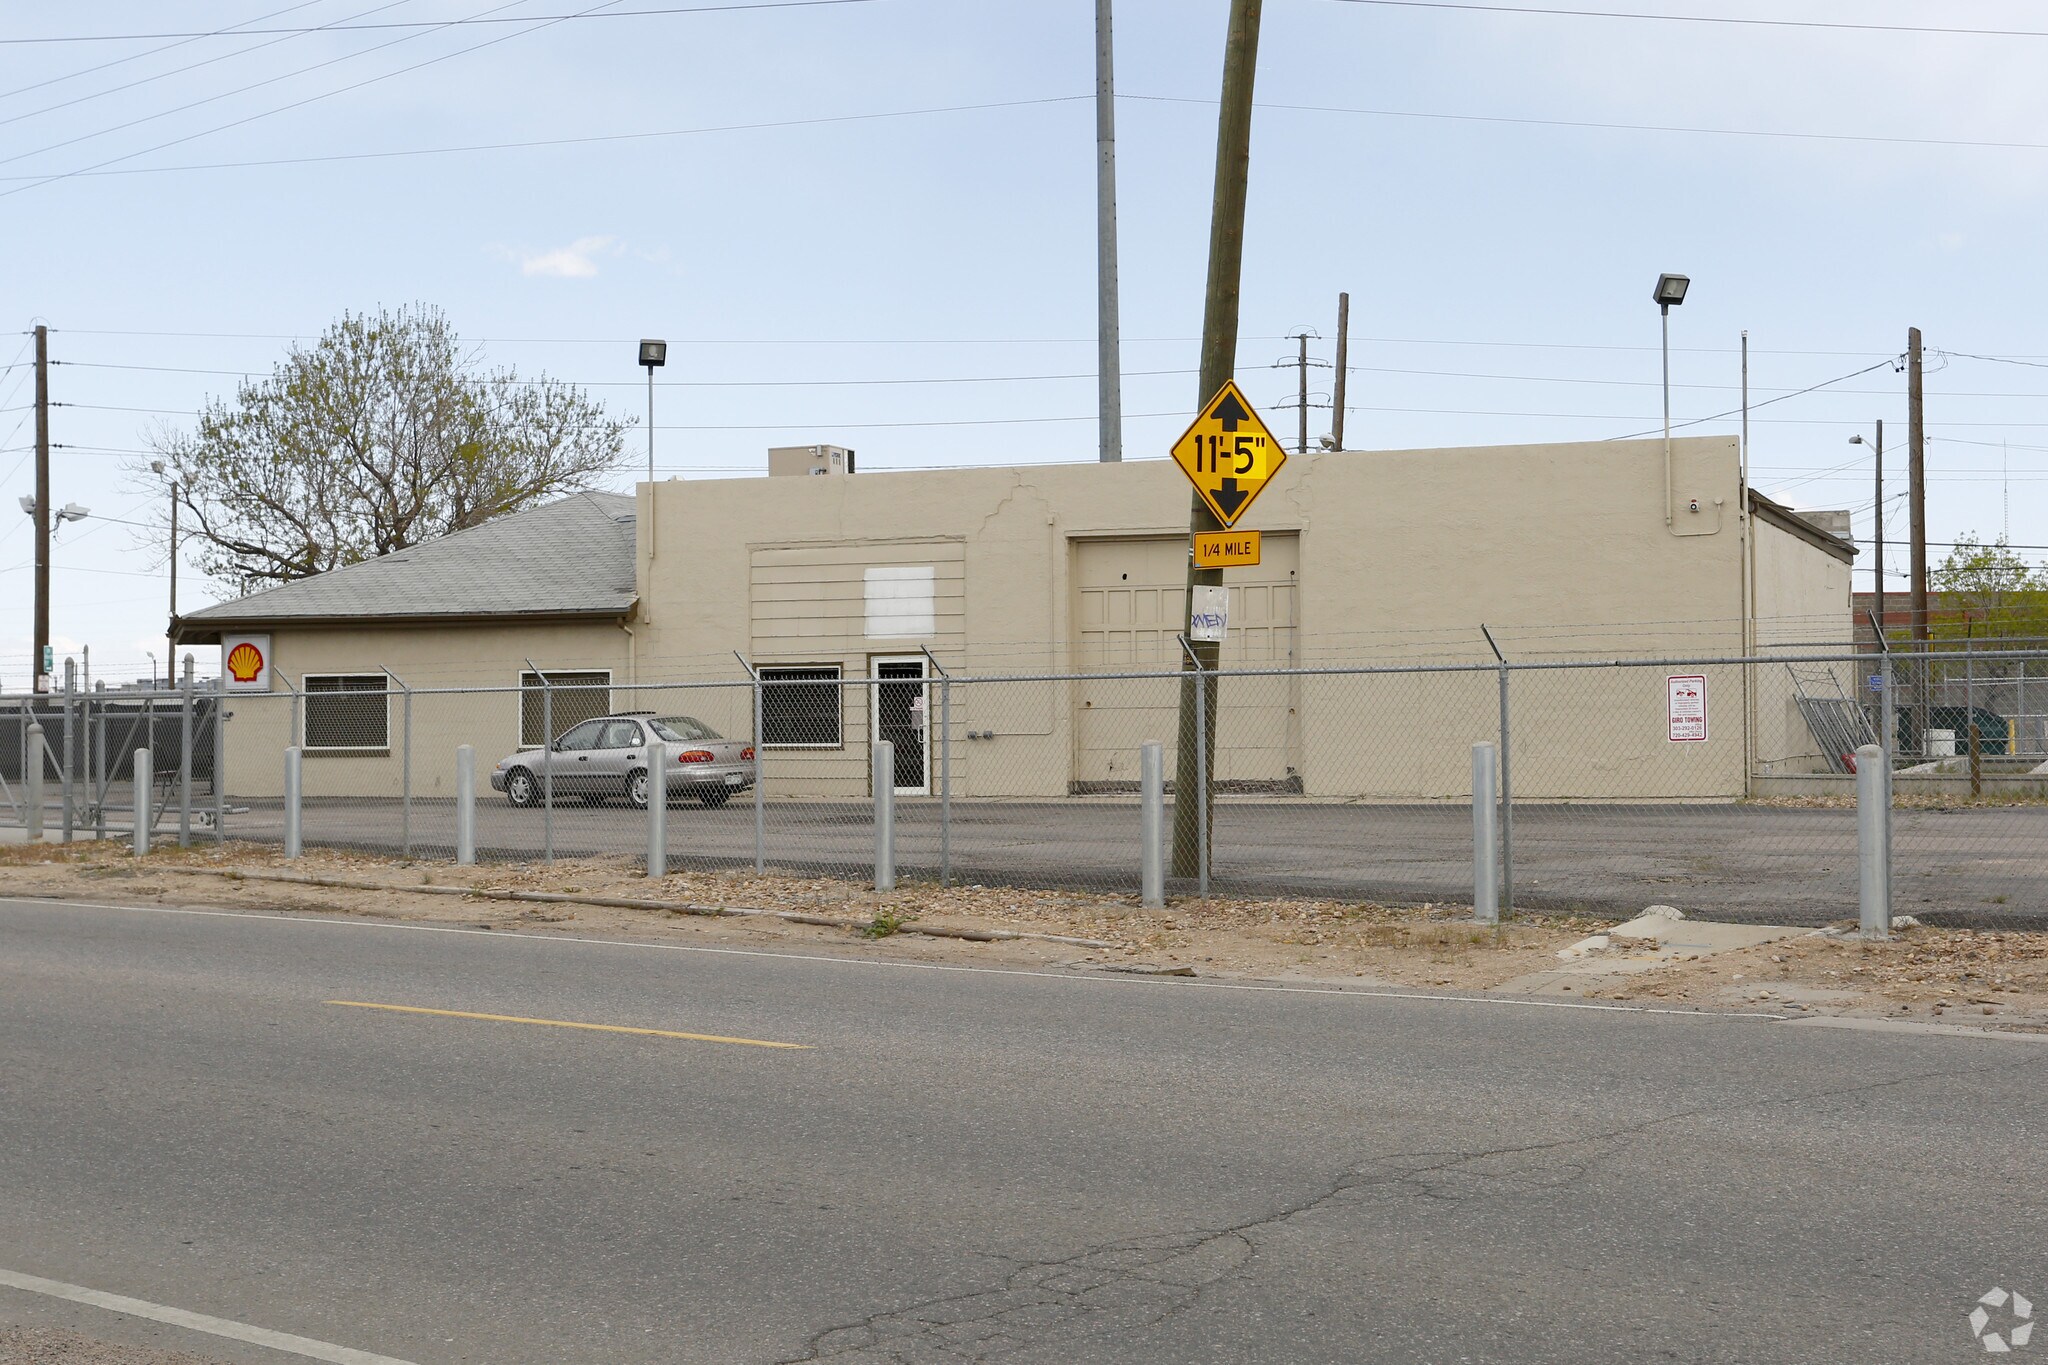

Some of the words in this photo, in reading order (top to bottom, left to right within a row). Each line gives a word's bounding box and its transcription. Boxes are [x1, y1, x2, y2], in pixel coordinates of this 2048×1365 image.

[1195, 434, 1265, 474] 11'-5"
[1203, 543, 1220, 557] 1/4
[1225, 541, 1251, 555] MILE
